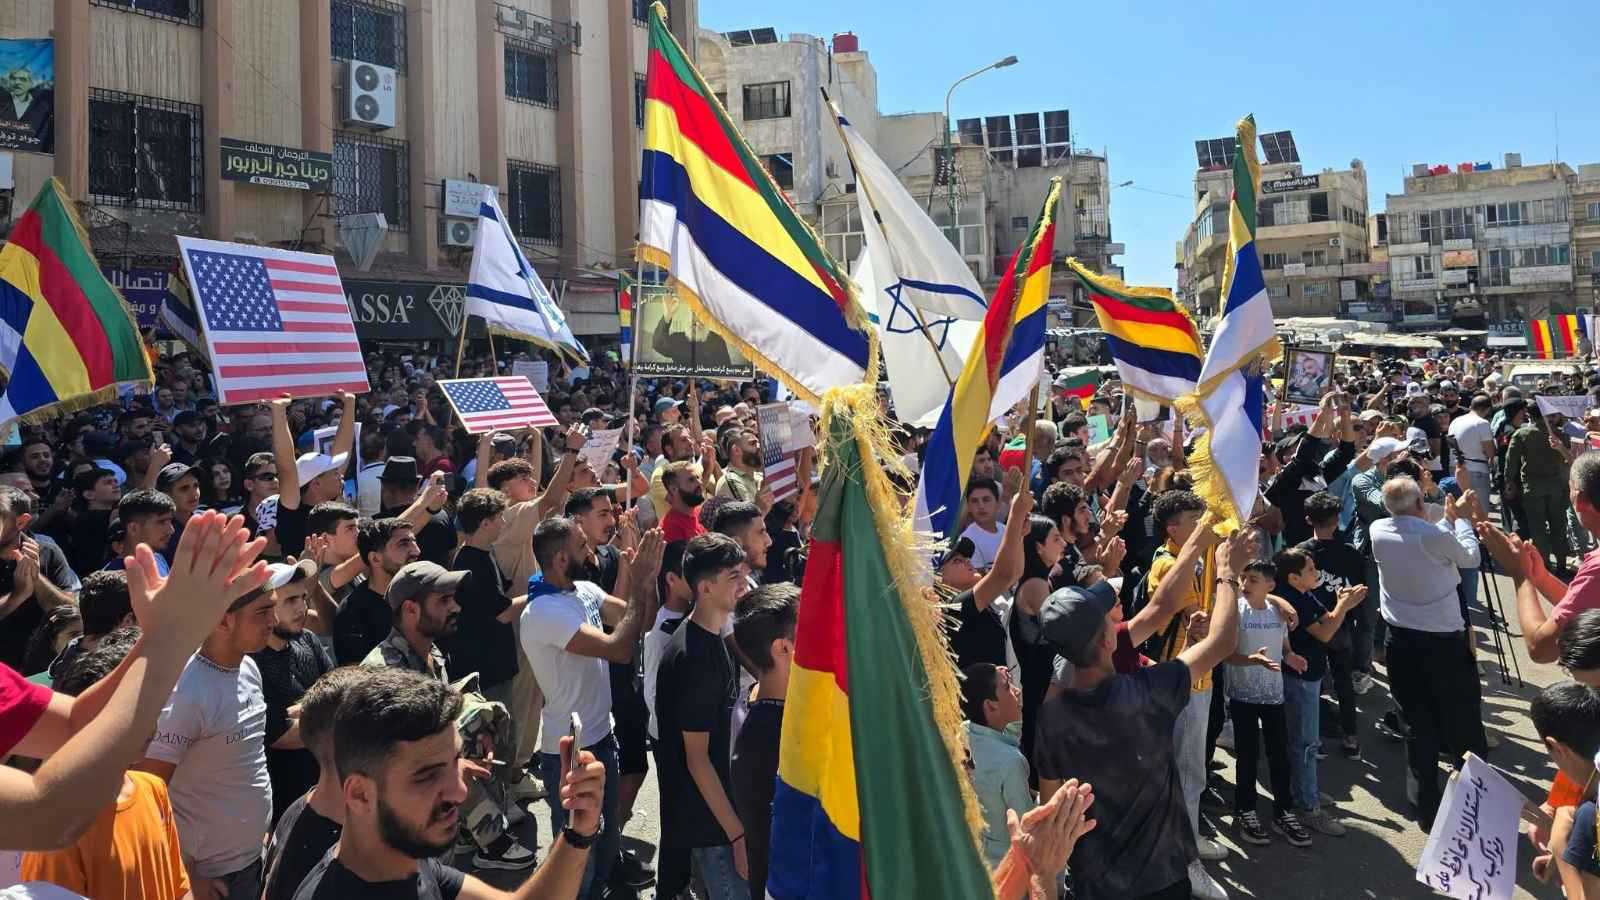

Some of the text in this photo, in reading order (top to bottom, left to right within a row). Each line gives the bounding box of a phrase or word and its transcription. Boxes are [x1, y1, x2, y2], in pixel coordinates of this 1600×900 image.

[245, 143, 309, 161] الترجمان المحلف
[301, 162, 329, 182] دينا
